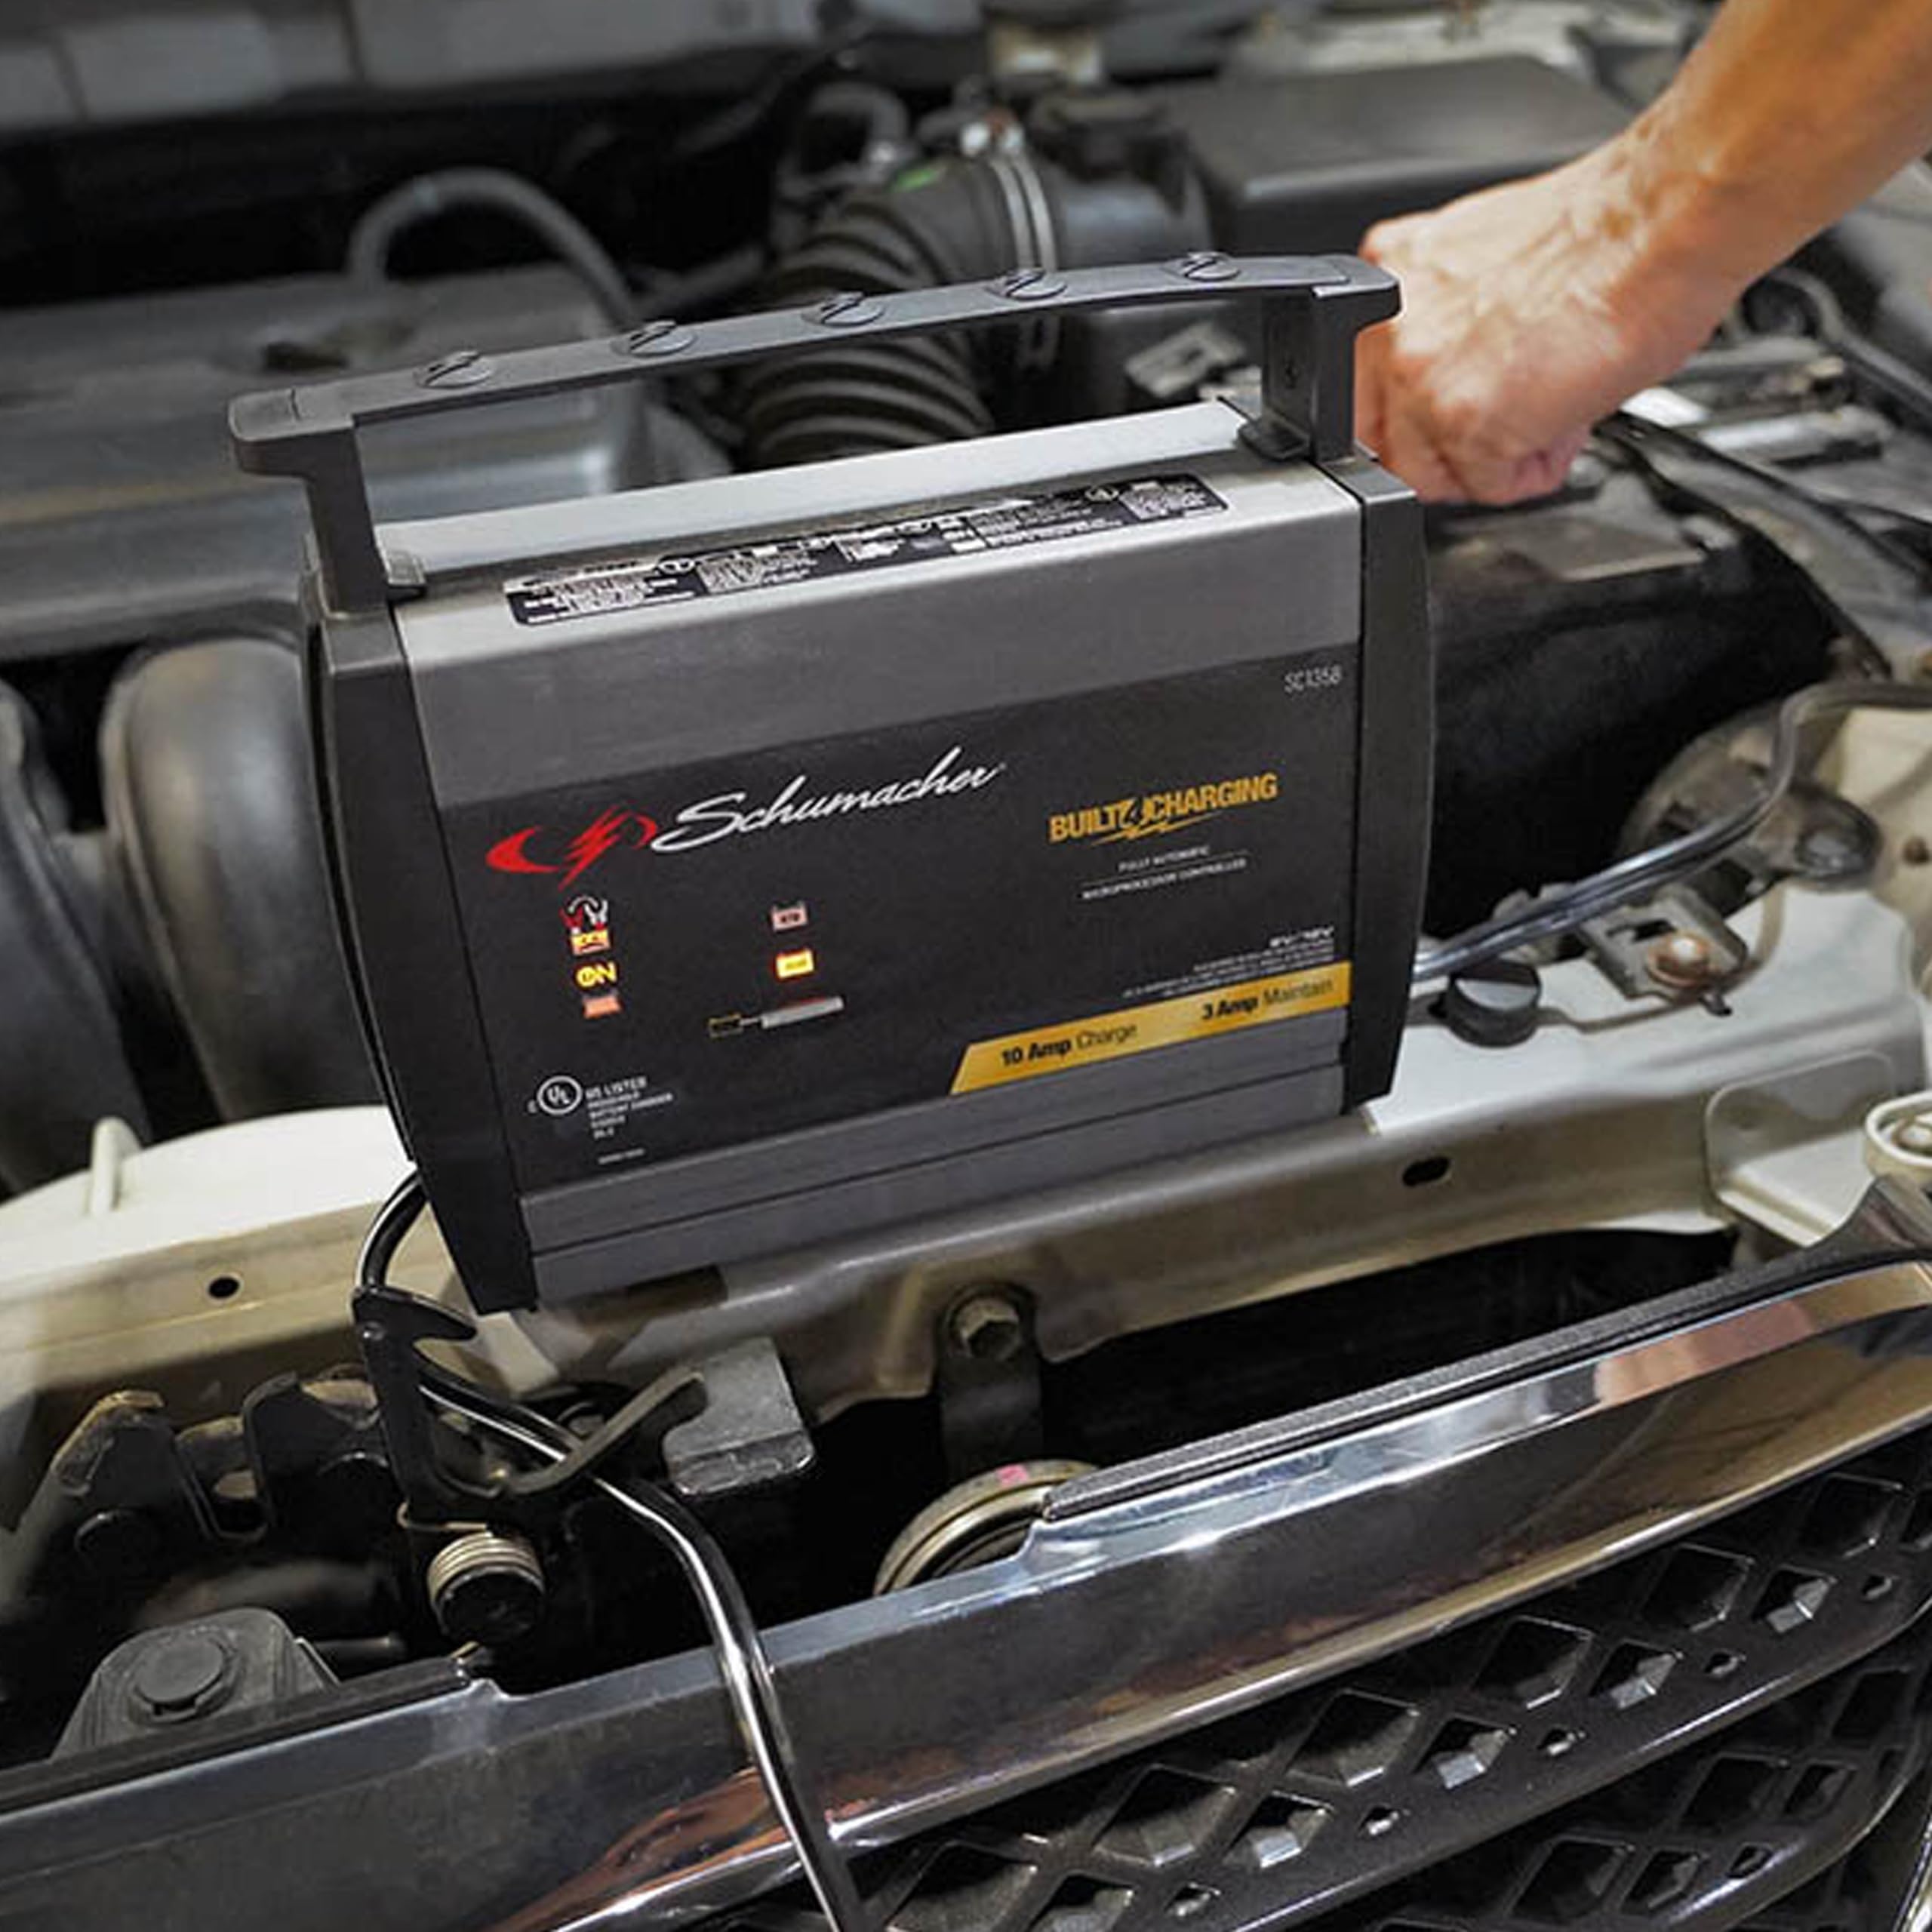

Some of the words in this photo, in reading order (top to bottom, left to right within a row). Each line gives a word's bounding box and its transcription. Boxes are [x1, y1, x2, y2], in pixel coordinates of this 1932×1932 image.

[651, 746, 1004, 851] Schumacher
[576, 960, 617, 988] ON
[1202, 1002, 1214, 1020] 3
[1216, 996, 1260, 1017] Amp
[1263, 979, 1334, 1005] Maintain
[1001, 1045, 1023, 1066] 10
[1028, 1038, 1072, 1062] Amp
[1076, 1024, 1138, 1049] Charge
